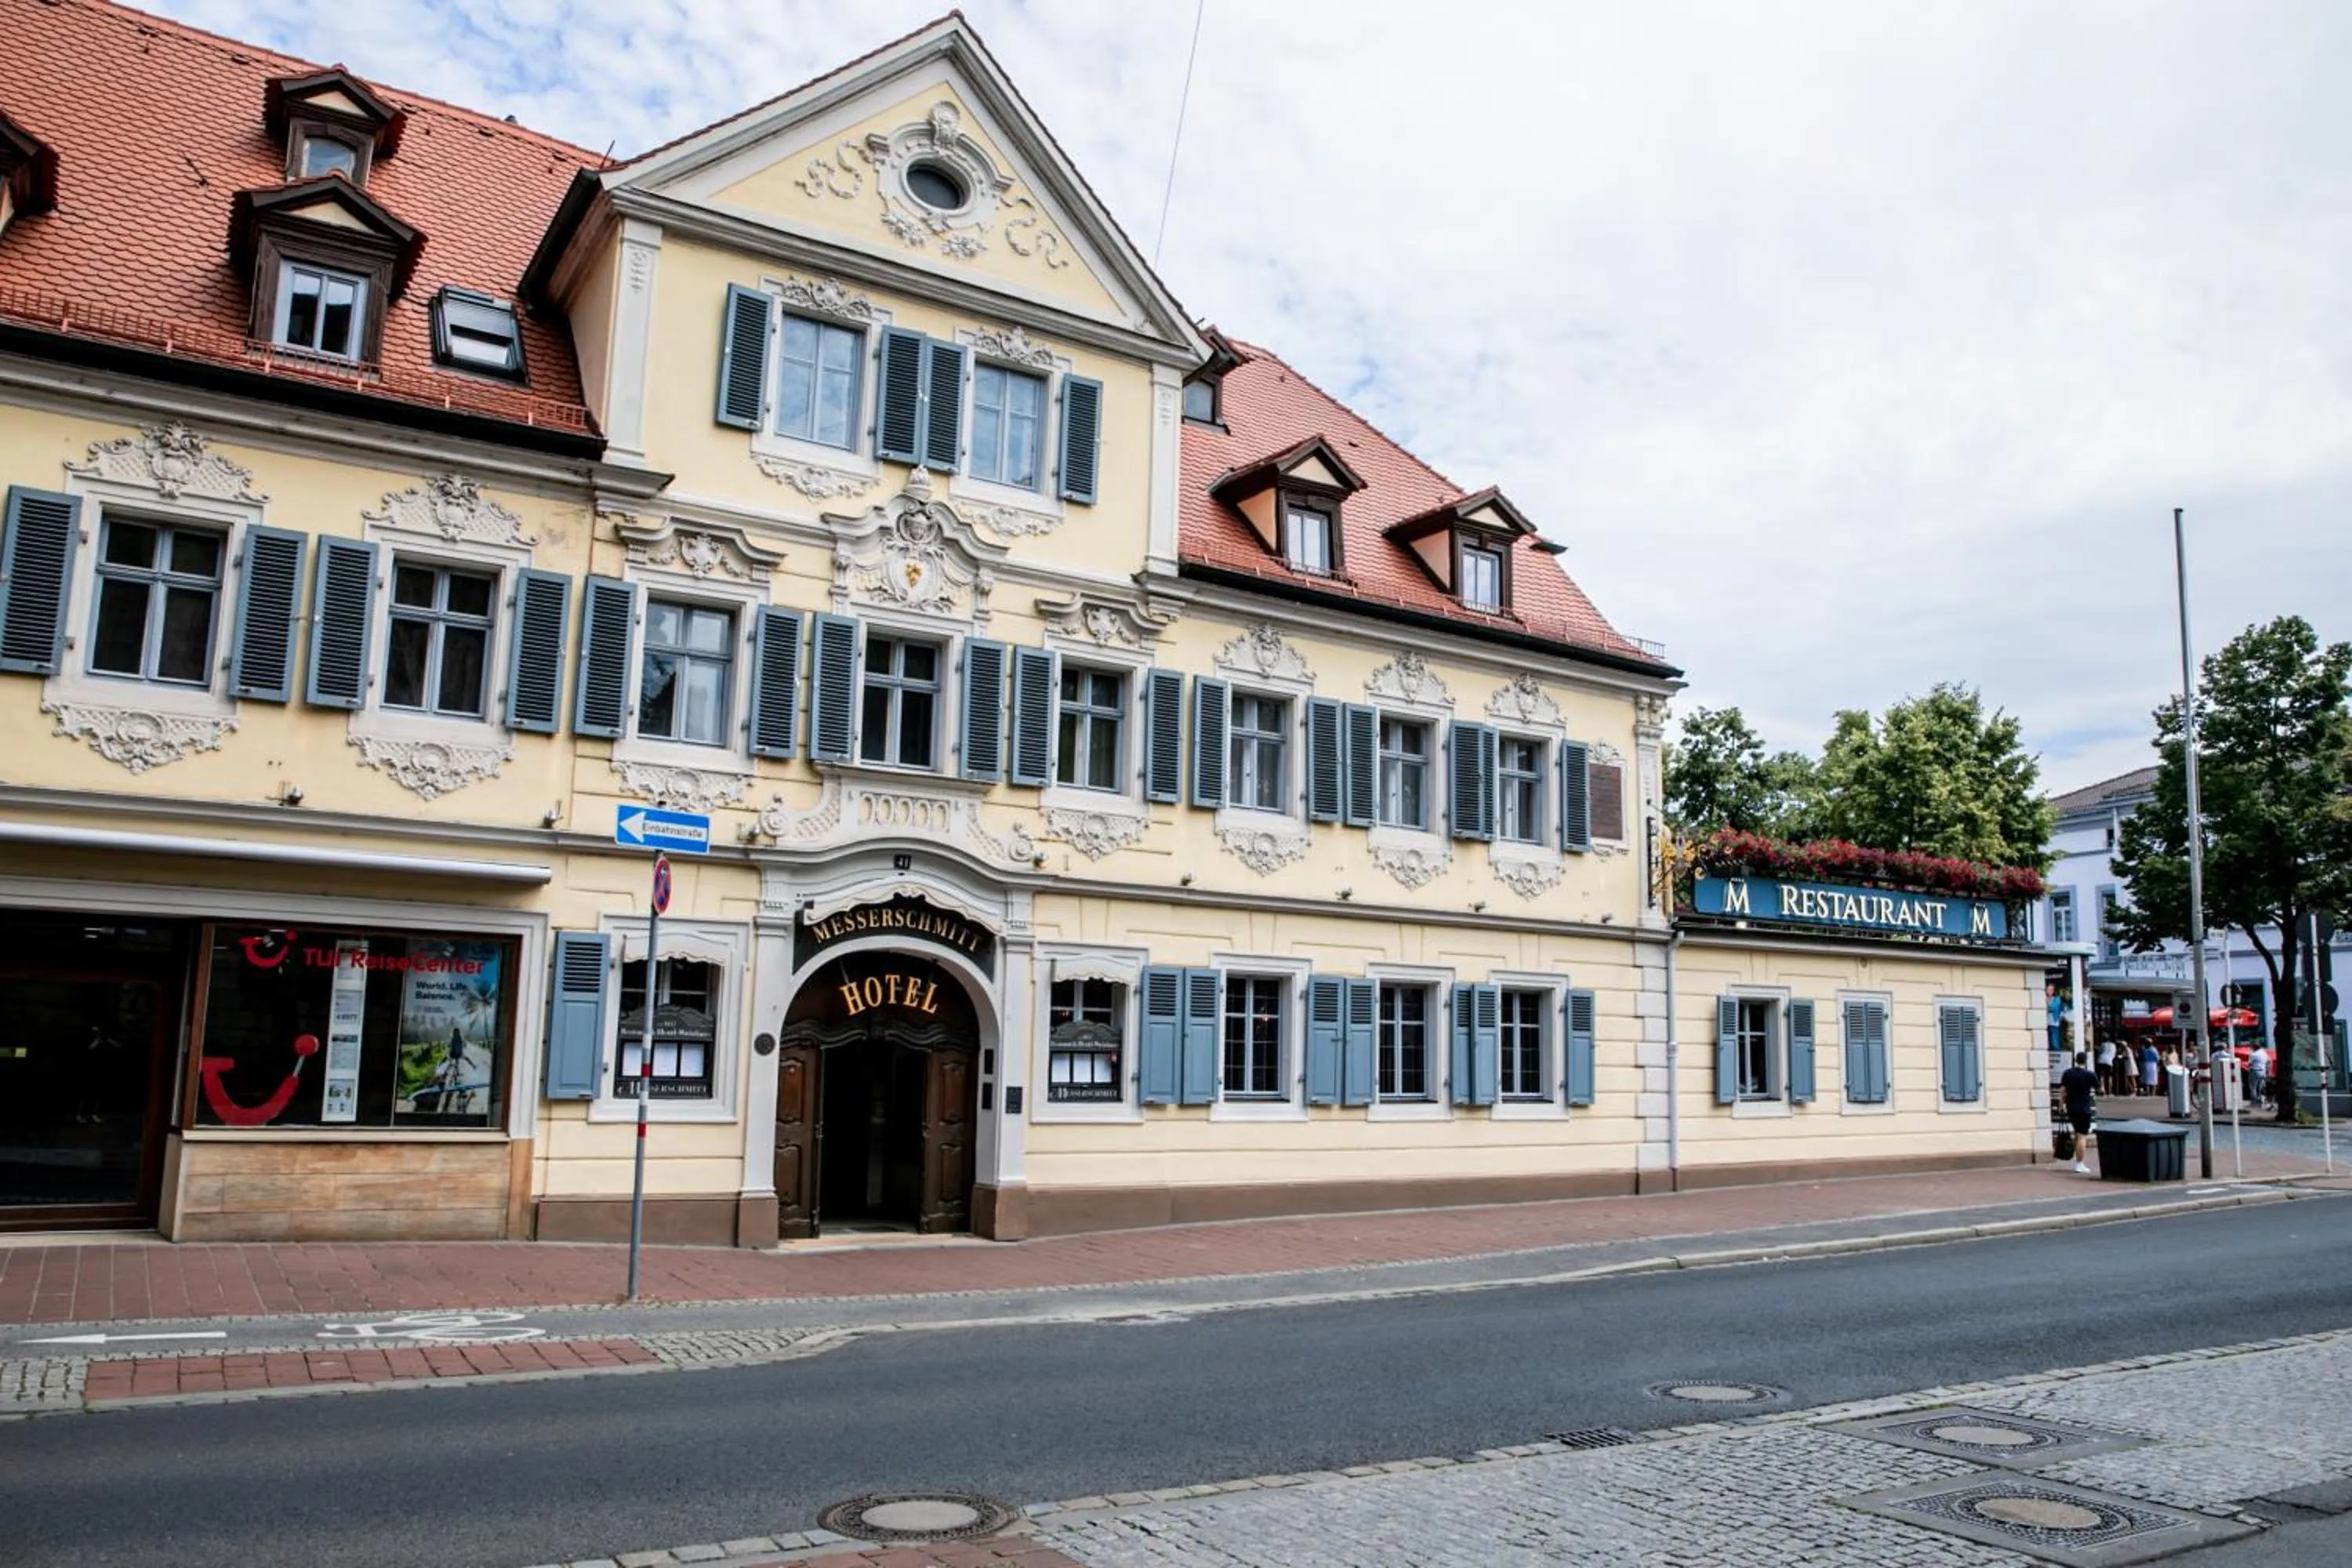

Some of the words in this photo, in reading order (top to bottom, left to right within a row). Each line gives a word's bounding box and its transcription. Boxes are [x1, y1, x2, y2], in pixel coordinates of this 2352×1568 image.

[642, 822, 703, 838] Einbahnstraße
[1780, 884, 1947, 929] RESTAURANT
[812, 908, 982, 953] MESSERSCHMITT
[303, 948, 340, 967] TUI
[840, 975, 938, 1015] HOTEL
